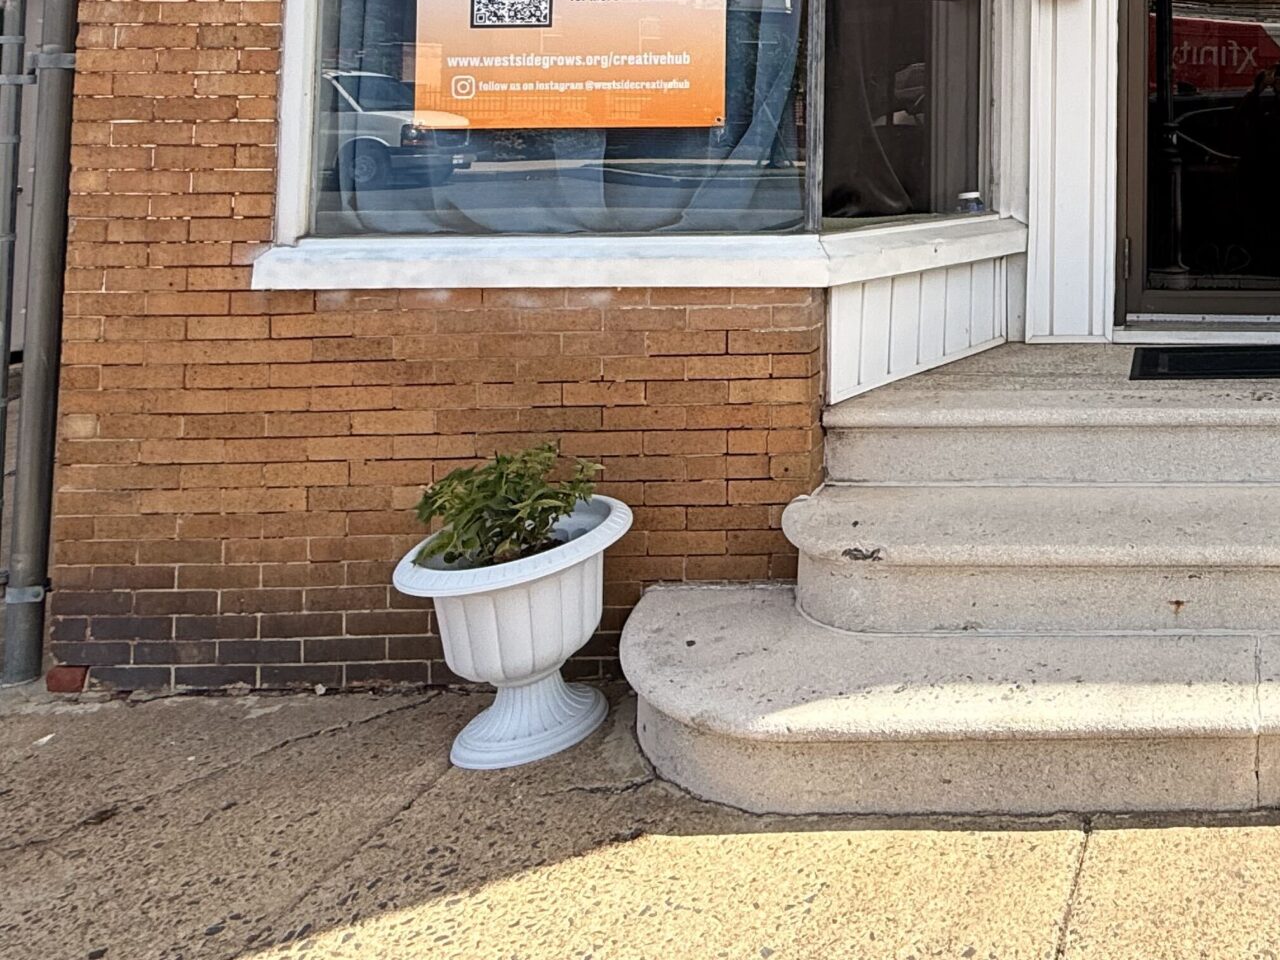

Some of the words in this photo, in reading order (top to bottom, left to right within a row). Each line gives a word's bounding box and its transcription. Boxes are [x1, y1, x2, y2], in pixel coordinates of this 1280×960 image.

[447, 52, 690, 69] www.westsidegrows.org/creativehub
[479, 81, 508, 91] follow
[510, 82, 521, 91] us
[523, 82, 534, 91] on
